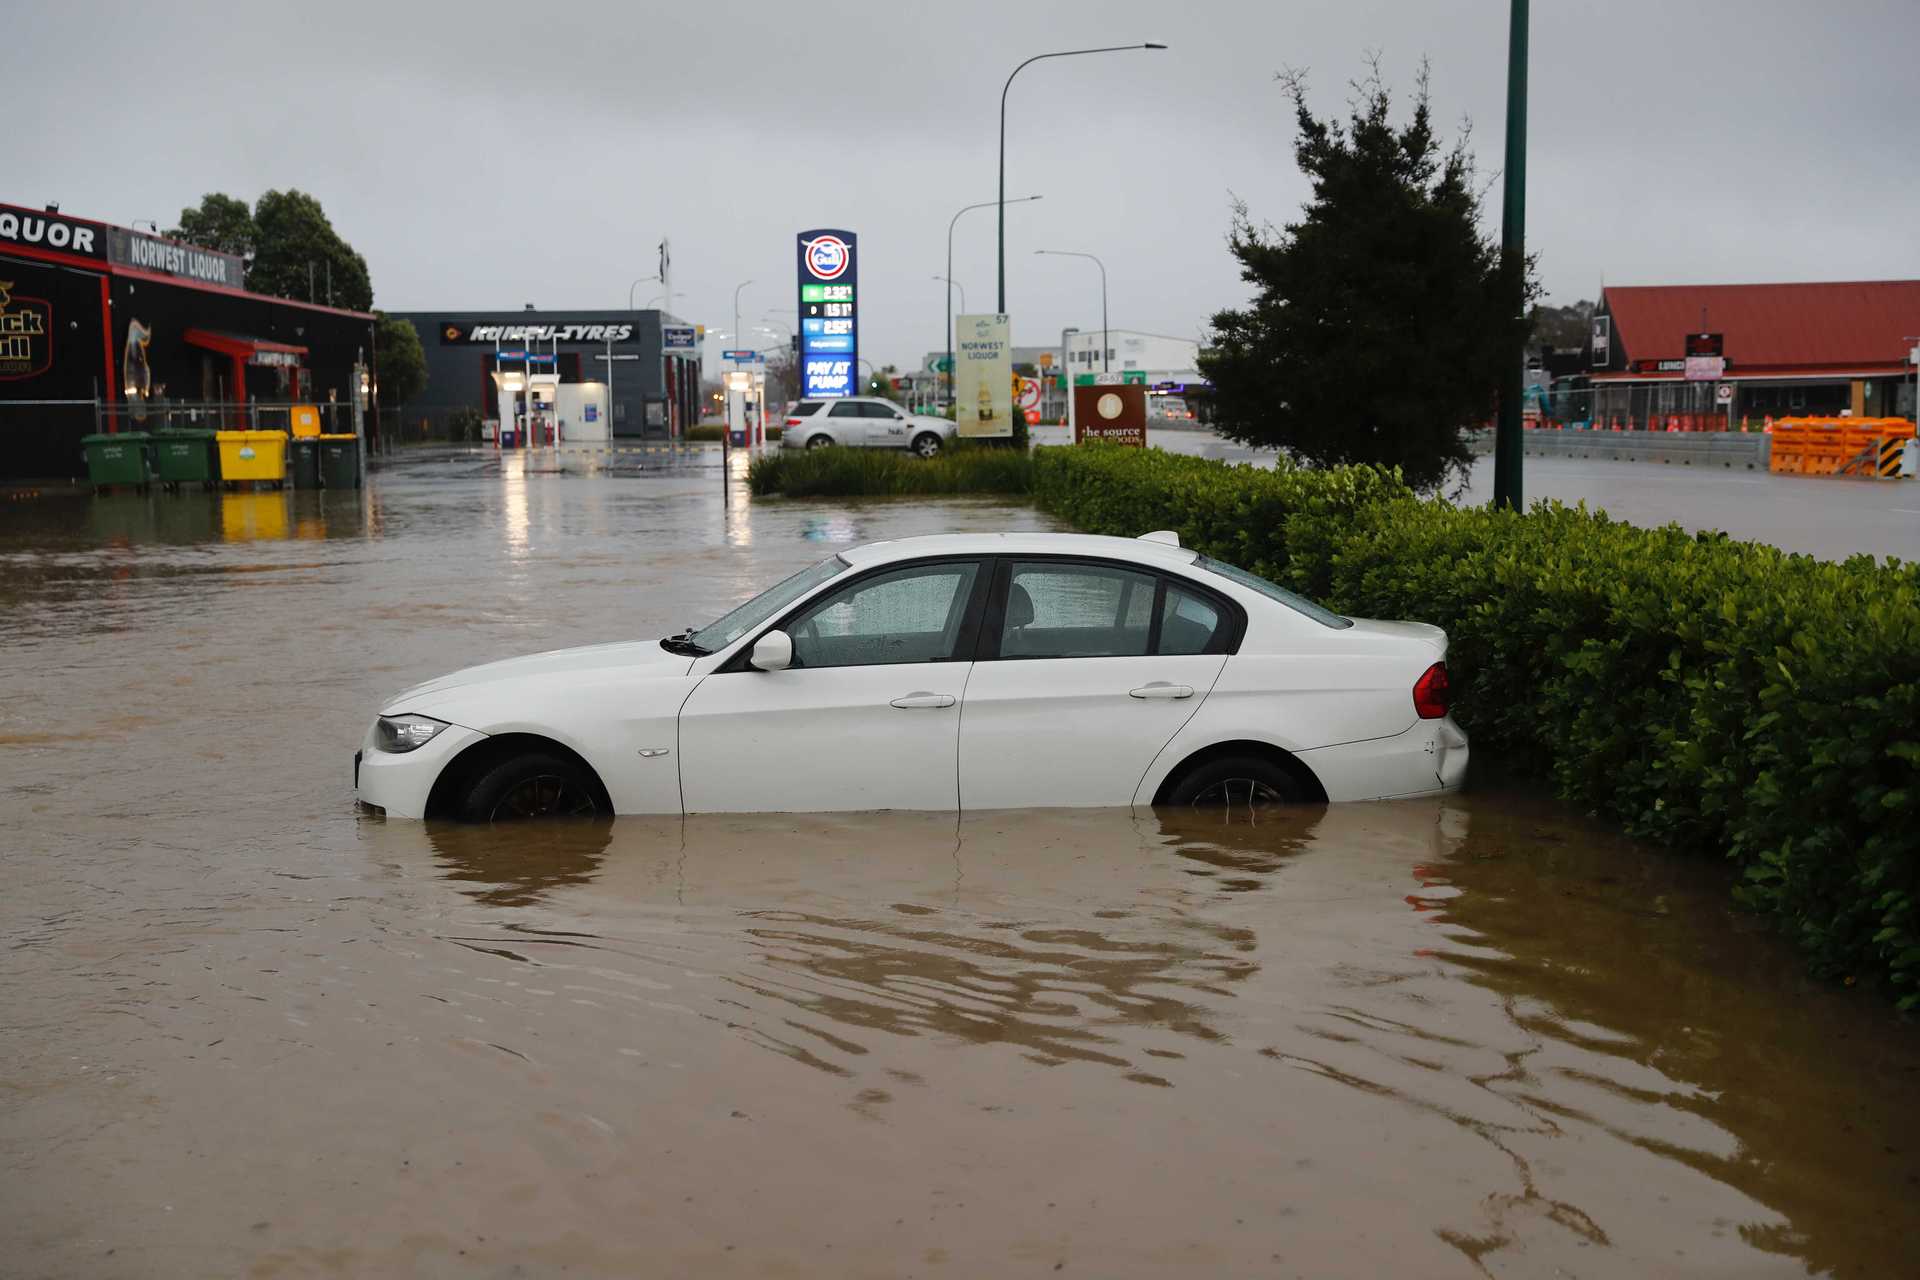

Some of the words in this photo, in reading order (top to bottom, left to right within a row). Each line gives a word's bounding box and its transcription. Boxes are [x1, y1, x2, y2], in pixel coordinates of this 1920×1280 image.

[131, 236, 186, 274] NORWEST
[188, 252, 227, 282] LIQUOR
[996, 314, 1009, 325] 57
[561, 324, 633, 341] TYRES
[961, 340, 1004, 351] NORWEST
[967, 351, 999, 361] LIQUOR
[807, 361, 834, 375] PAY
[832, 361, 851, 375] AT
[809, 375, 848, 389] PUMP
[1102, 426, 1141, 437] source
